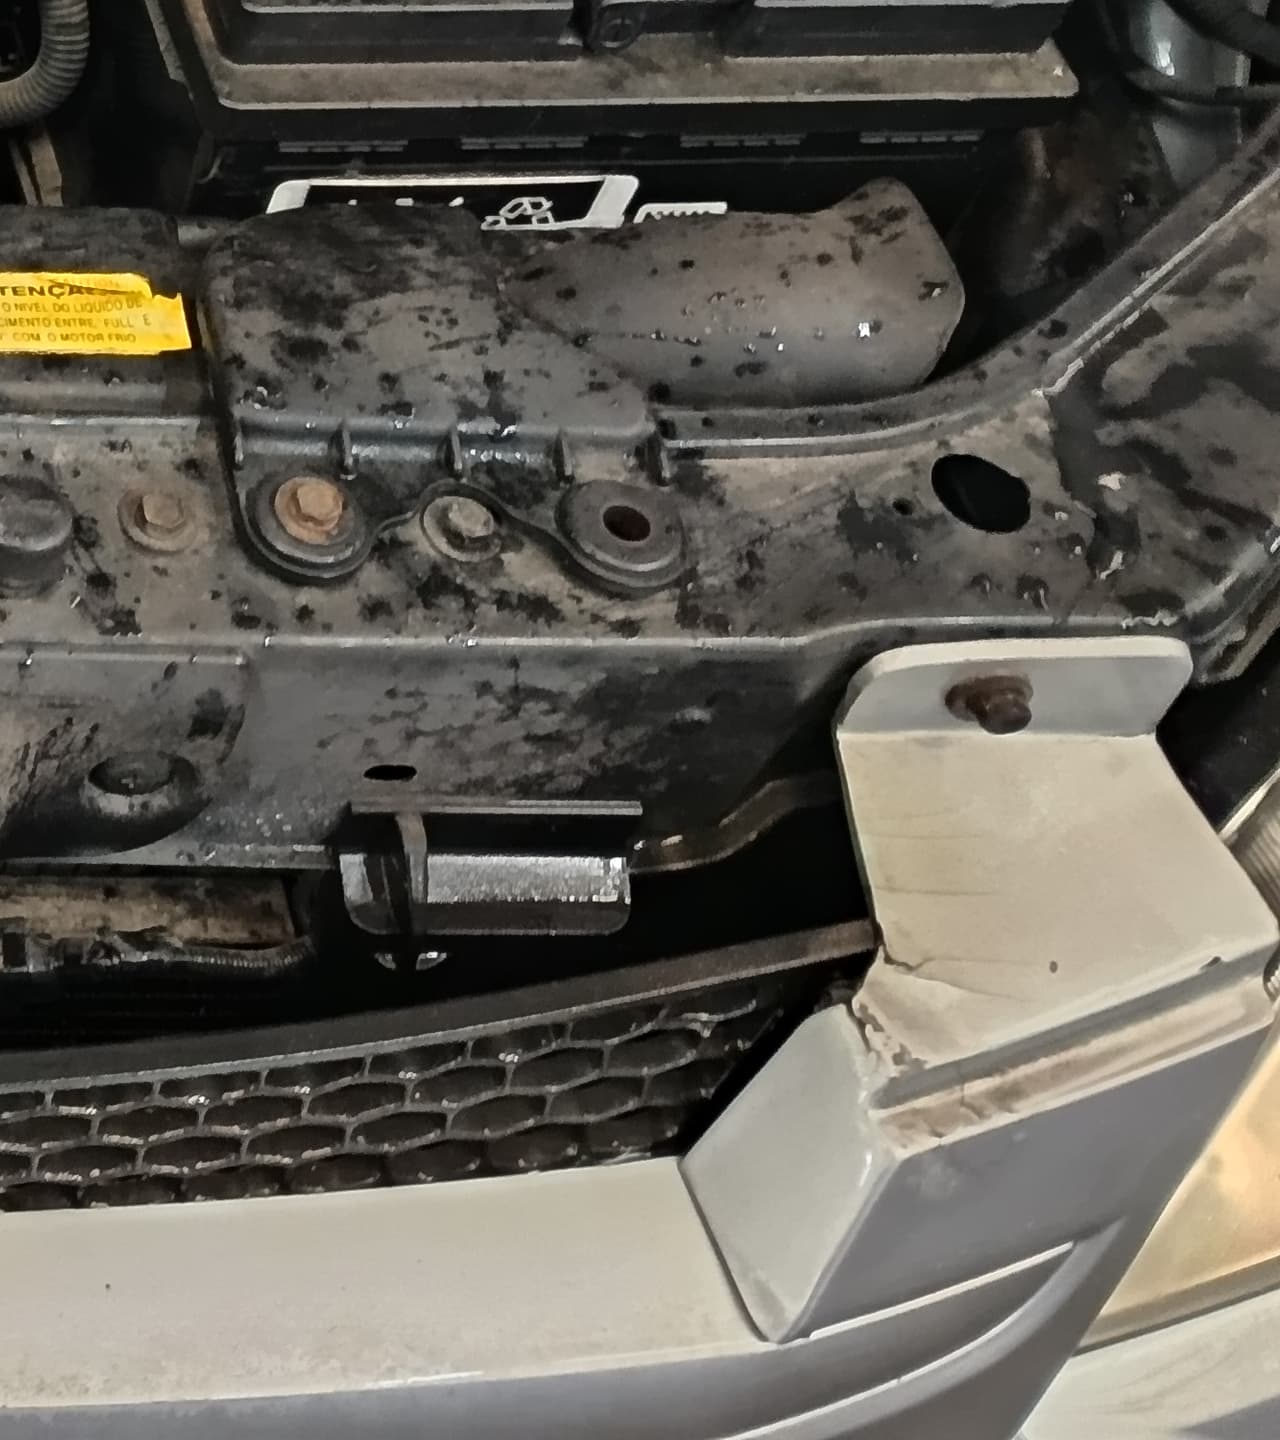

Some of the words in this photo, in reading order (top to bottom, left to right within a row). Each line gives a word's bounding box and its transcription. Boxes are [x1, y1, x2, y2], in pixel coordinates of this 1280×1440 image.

[2, 302, 12, 313] O
[52, 302, 70, 313] DO
[12, 331, 41, 342] COM
[47, 332, 57, 342] O
[60, 332, 105, 343] MOTOR
[107, 332, 137, 343] FRIO
